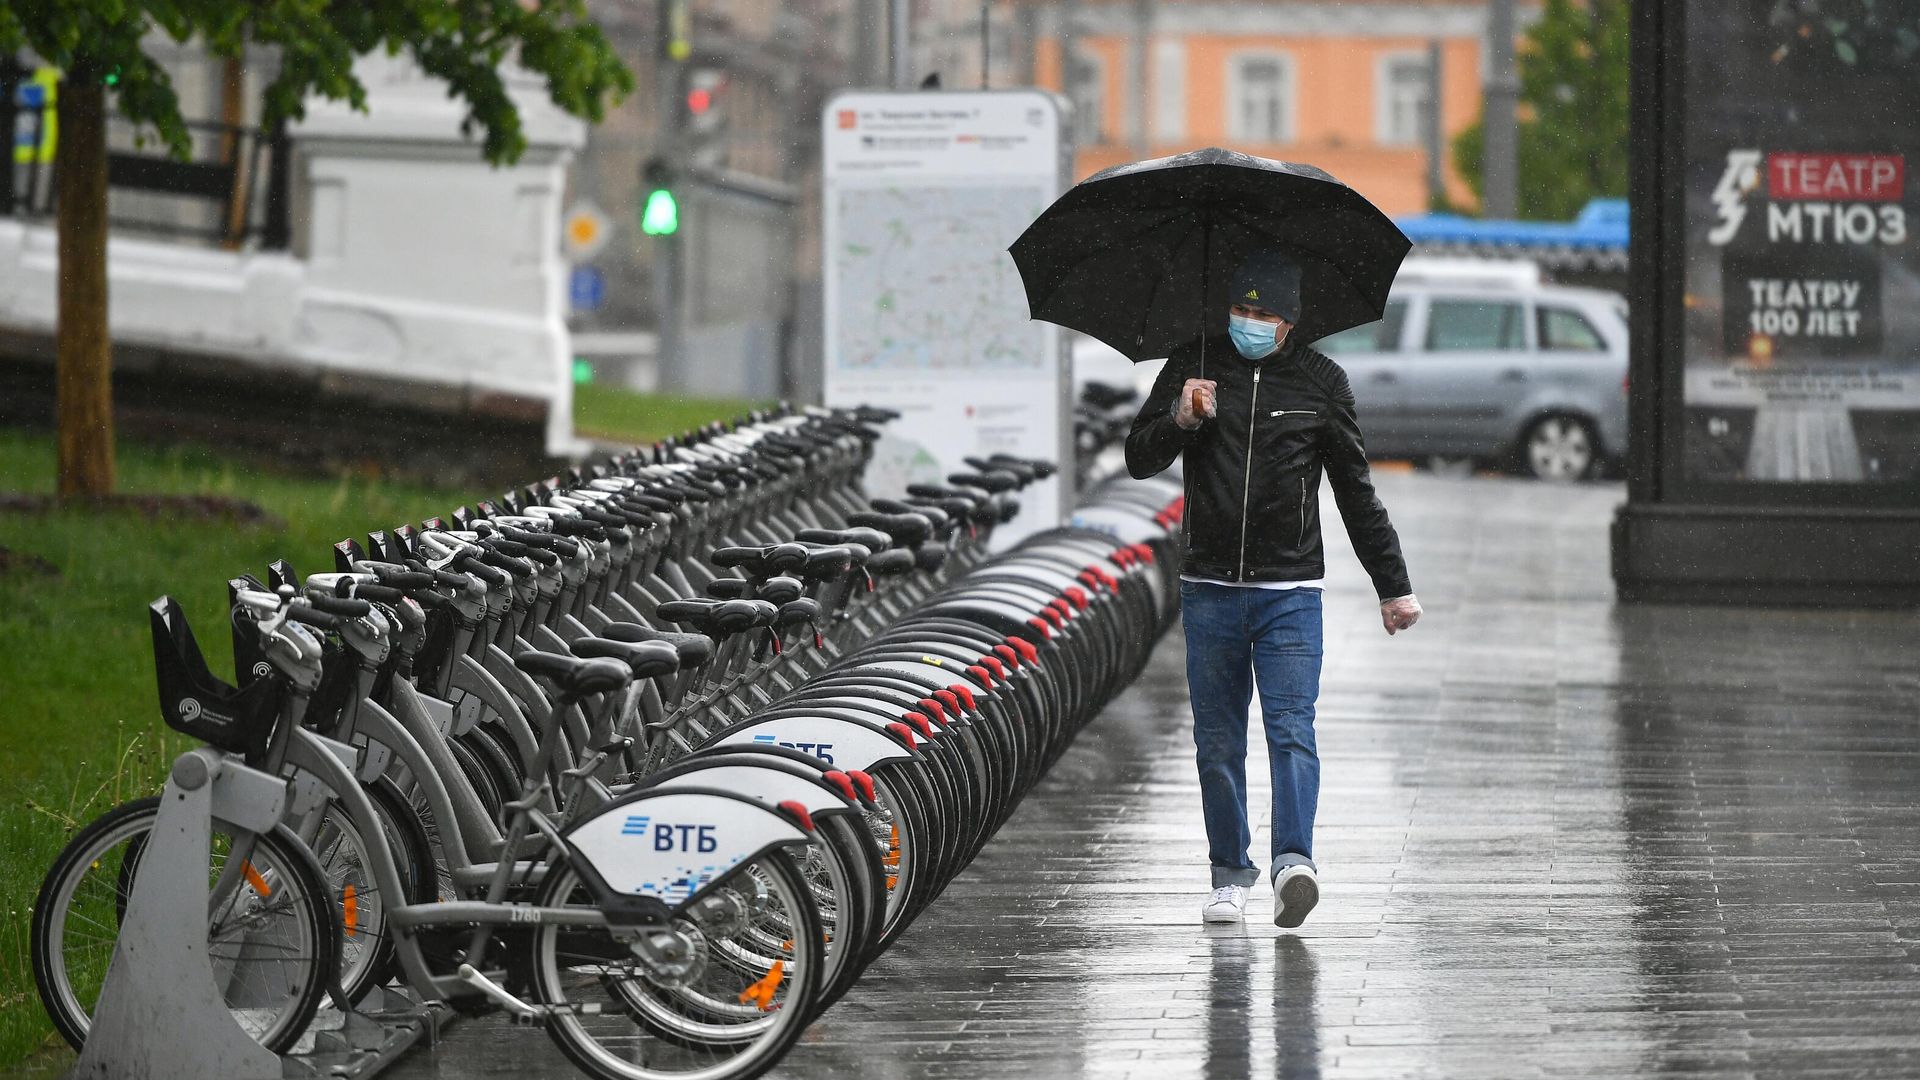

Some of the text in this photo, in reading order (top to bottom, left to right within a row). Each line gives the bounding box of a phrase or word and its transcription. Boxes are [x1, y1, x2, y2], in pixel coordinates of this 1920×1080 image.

[1775, 159, 1896, 194] ТЕАТР
[1768, 202, 1907, 244] МТЮЗ
[1748, 279, 1860, 308] ТЕАТРУ
[1749, 310, 1861, 337] 100 ЛЕТ
[655, 824, 718, 852] ВТБ
